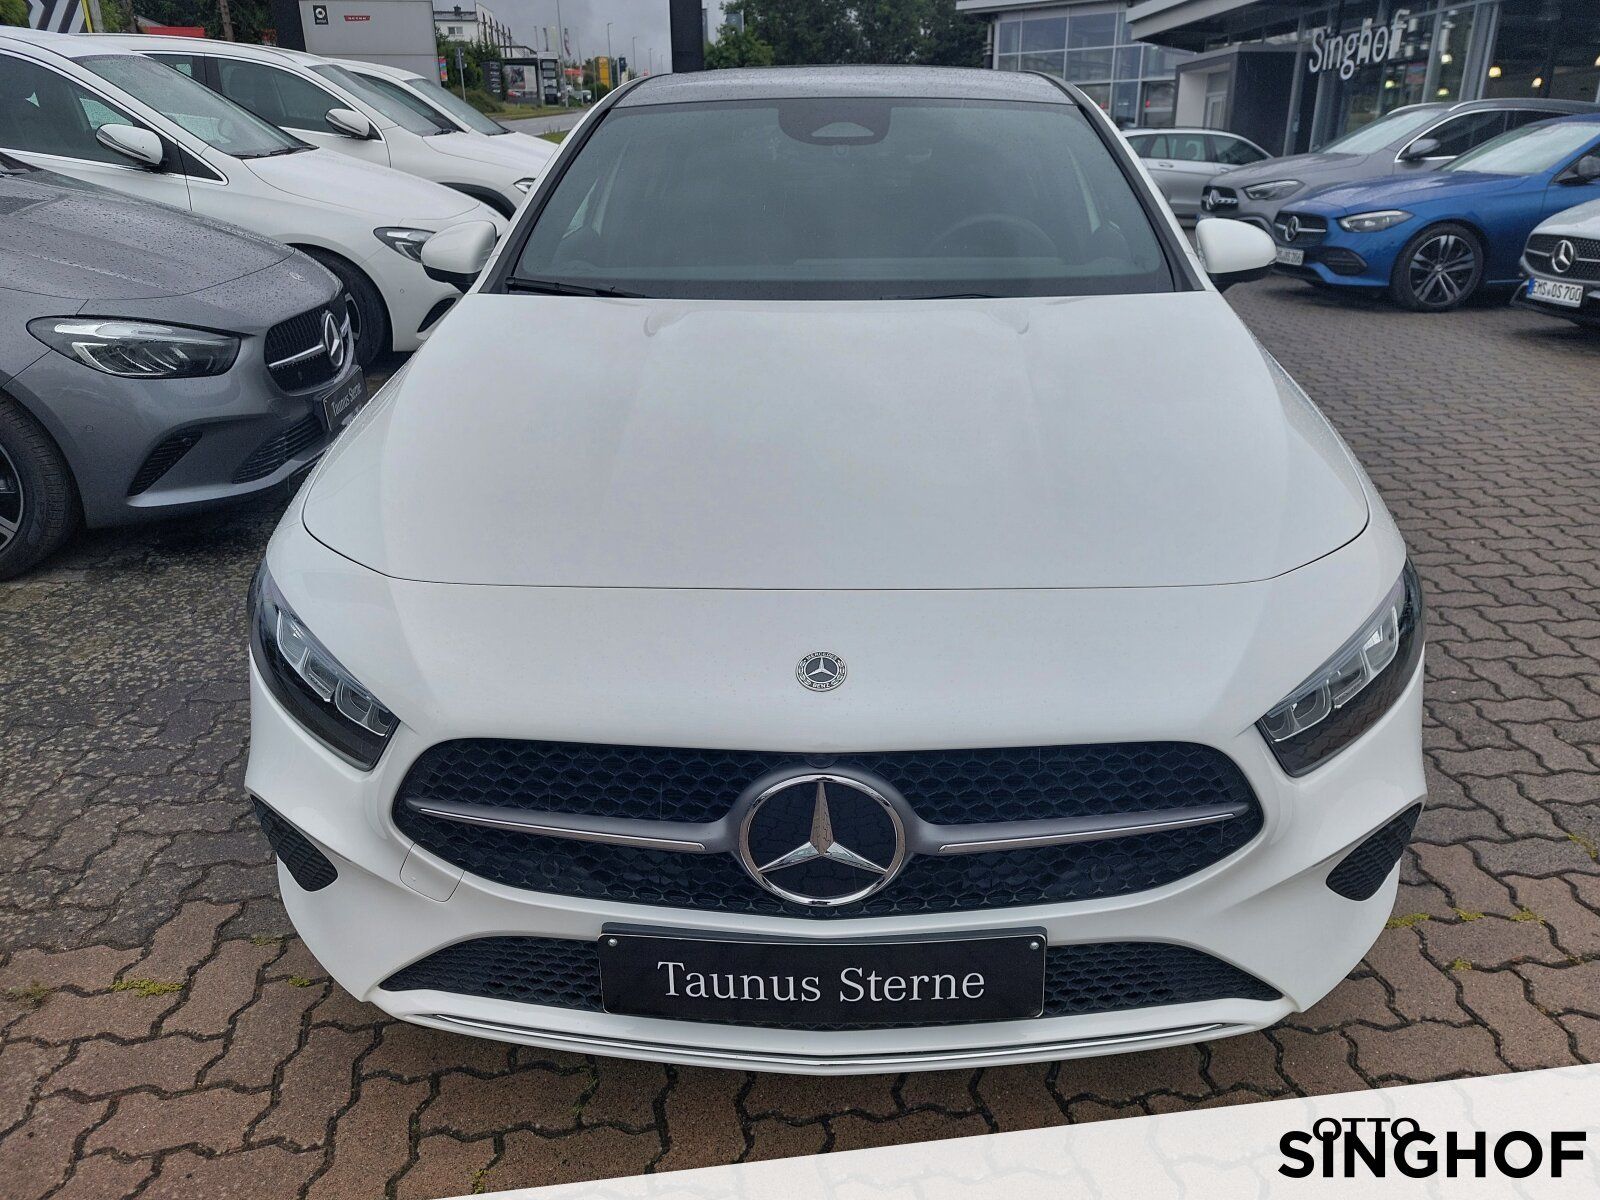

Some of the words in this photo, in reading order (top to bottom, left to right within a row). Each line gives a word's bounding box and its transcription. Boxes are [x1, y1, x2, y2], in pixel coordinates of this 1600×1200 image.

[1309, 9, 1411, 80] Singhof
[1564, 286, 1581, 301] 700
[657, 961, 821, 1003] Taunus
[839, 967, 985, 1003] Sterne
